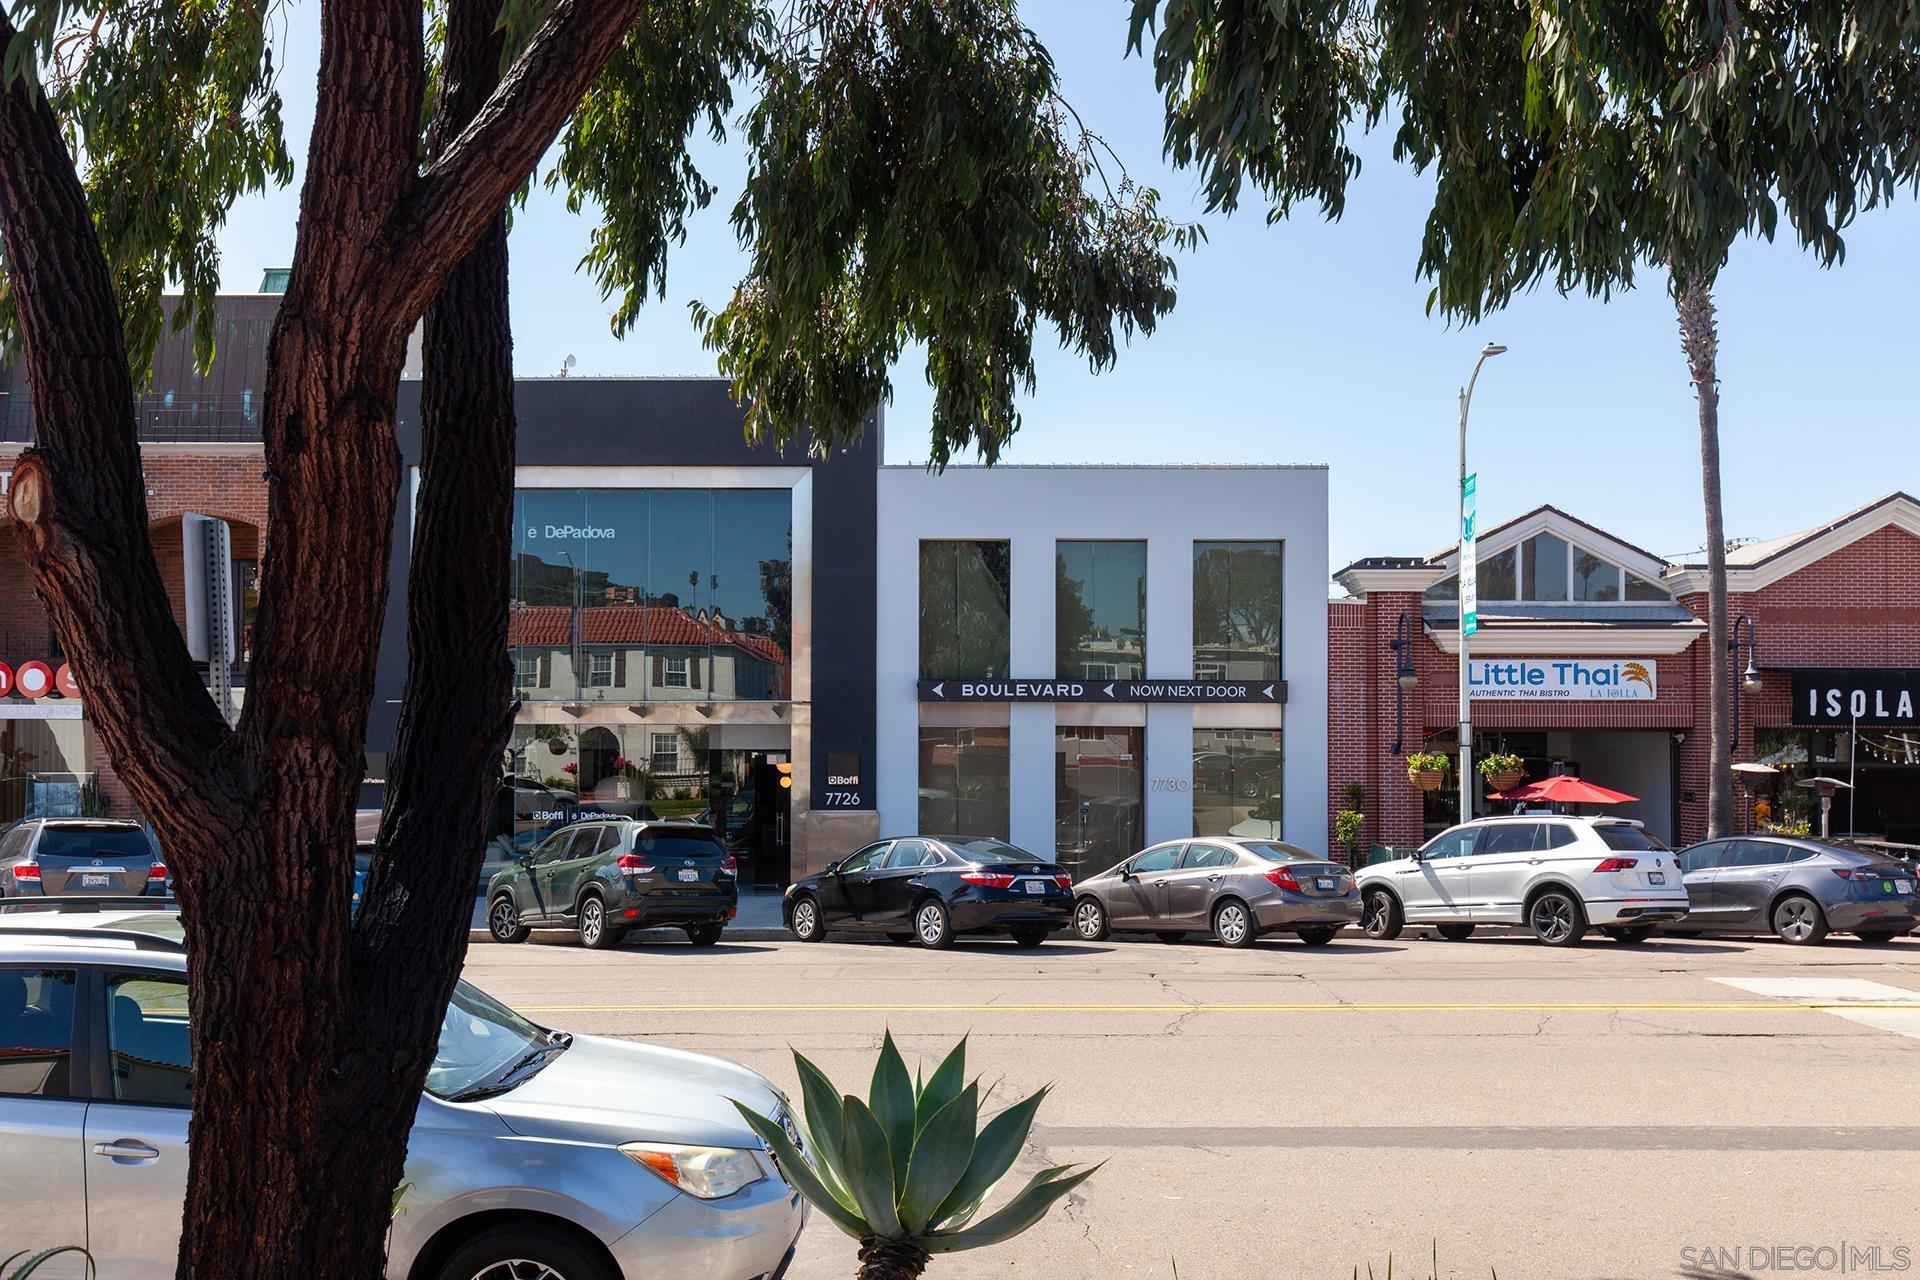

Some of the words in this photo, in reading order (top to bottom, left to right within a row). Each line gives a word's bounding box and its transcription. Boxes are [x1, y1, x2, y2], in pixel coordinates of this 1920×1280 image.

[544, 525, 616, 539] DePadova
[1469, 662, 1545, 686] Little
[1552, 662, 1619, 686] Thai
[961, 684, 1084, 697] BOULEVARD
[1130, 685, 1165, 697] NOW
[1168, 685, 1203, 697] NEXT
[1206, 686, 1247, 698] DOOR
[1469, 689, 1516, 697] AUTHENTIC
[1519, 689, 1538, 697] THAI
[1539, 689, 1570, 697] BISTRO
[1590, 689, 1603, 698] LA
[1607, 688, 1639, 698] JOLLA
[1809, 688, 1914, 718] ISOLA
[837, 775, 859, 785] Boffi
[1151, 778, 1190, 791] 7730
[825, 792, 861, 806] 7726
[542, 811, 564, 820] Boffi
